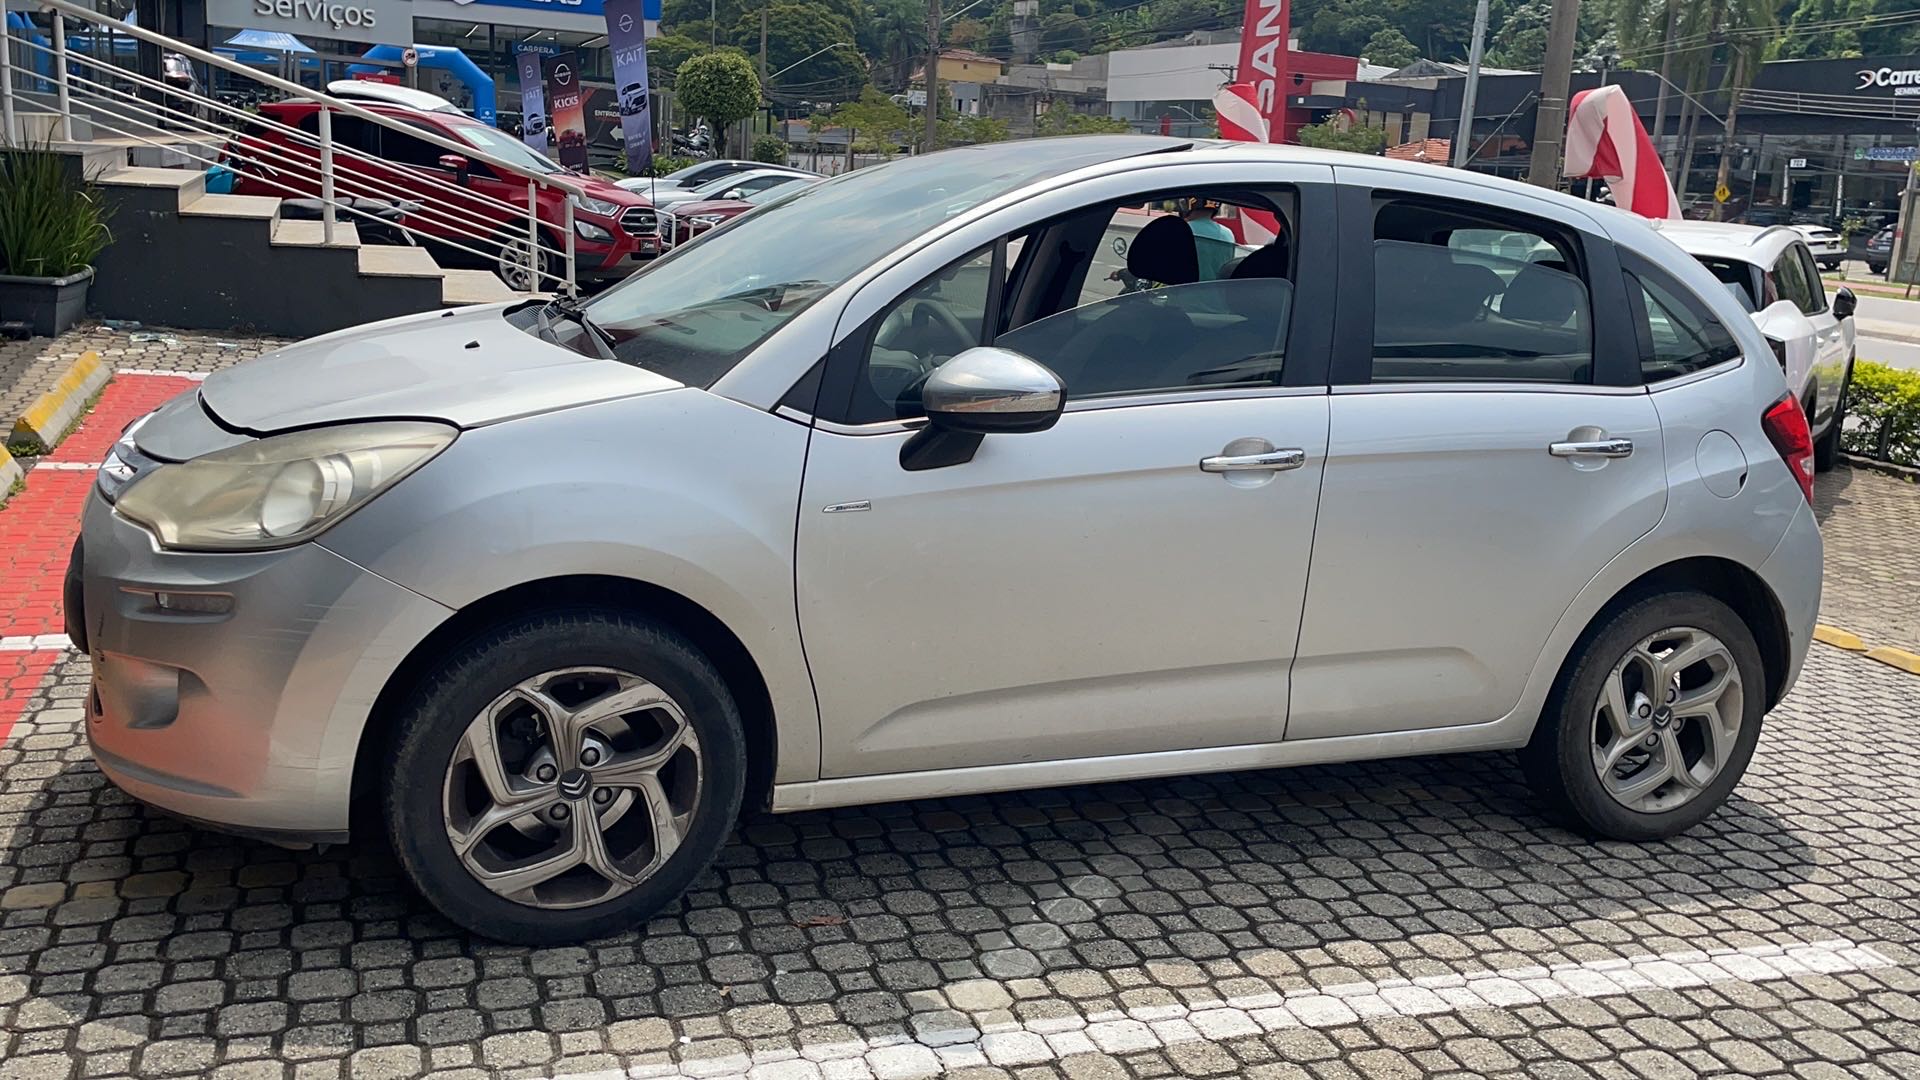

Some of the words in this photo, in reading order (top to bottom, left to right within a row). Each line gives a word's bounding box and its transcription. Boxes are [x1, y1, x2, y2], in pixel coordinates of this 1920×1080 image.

[256, 0, 376, 30] Serviços
[517, 44, 555, 55] CARRERA
[616, 47, 643, 67] KAIT
[554, 95, 579, 110] KICKS
